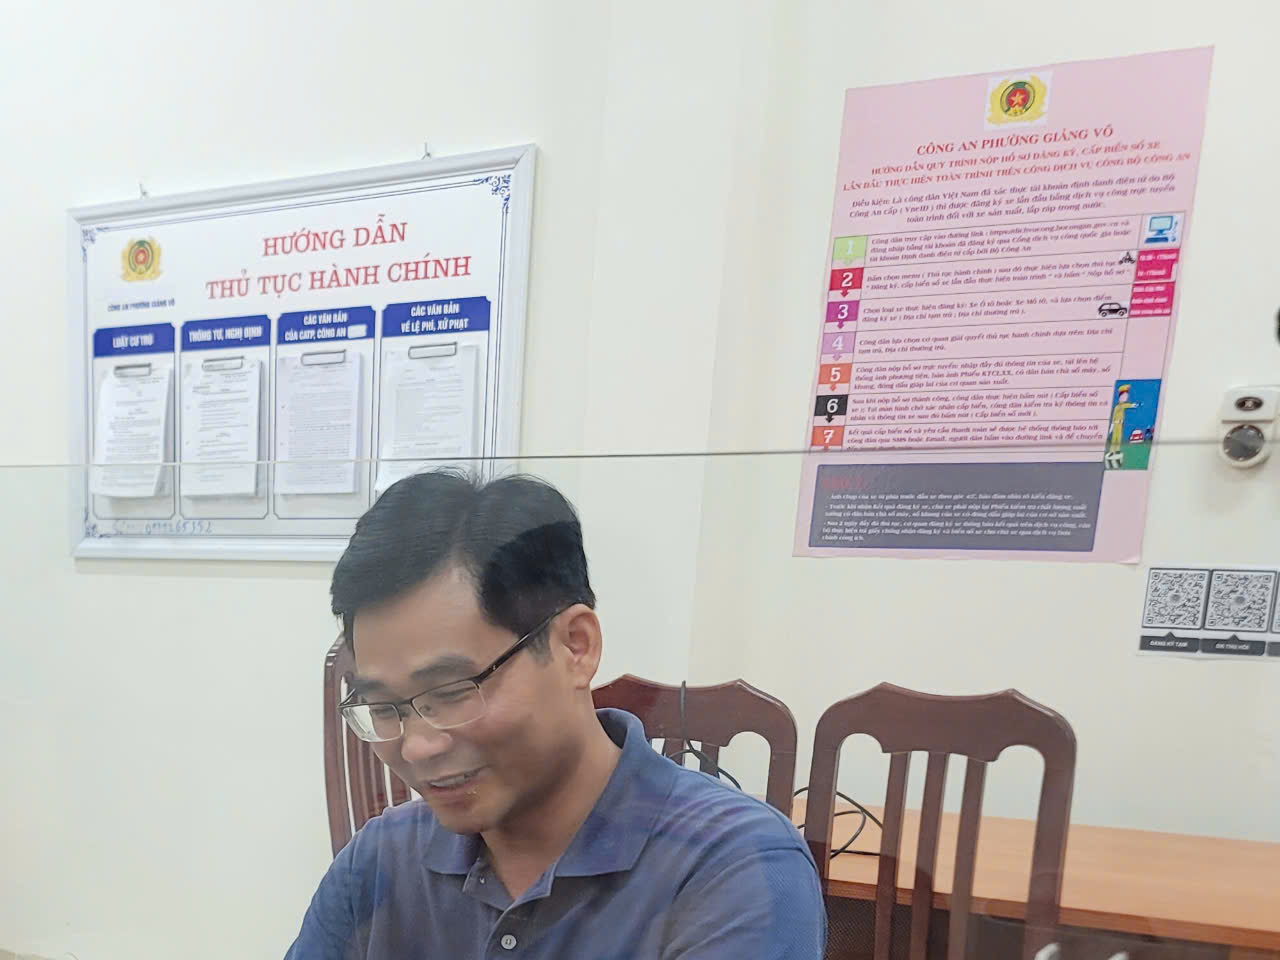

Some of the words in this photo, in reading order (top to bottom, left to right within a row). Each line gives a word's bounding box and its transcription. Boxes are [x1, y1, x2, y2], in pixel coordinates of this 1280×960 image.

[916, 140, 954, 155] CÔNG
[958, 140, 978, 151] AN
[980, 131, 1039, 149] PHƯỜNG
[1042, 126, 1089, 143] GIẢNG
[1092, 124, 1113, 138] VÕ
[904, 160, 924, 172] DẪN
[926, 161, 945, 171] QUY
[942, 192, 958, 200] Việt
[262, 223, 346, 256] HƯỚNG
[352, 210, 408, 246] DẪN
[847, 240, 853, 254] 1
[205, 268, 249, 299] THỦ
[257, 272, 302, 300] TỤC
[308, 259, 380, 290] HÀNH
[387, 248, 472, 282] CHÍNH
[842, 272, 852, 286] 2
[410, 303, 425, 316] CÁC
[426, 302, 442, 315] VĂN
[442, 300, 459, 314] BẢN
[838, 304, 848, 318] 3
[303, 313, 317, 325] CÁC
[400, 320, 410, 332] VỀ
[411, 320, 420, 332] LỆ
[421, 318, 435, 332] PHÍ,
[436, 316, 448, 330] XỬ
[448, 316, 468, 330] PHẠT
[188, 328, 211, 342] THÔNG
[224, 326, 243, 341] NGHỊ
[244, 325, 262, 340] ĐỊNH
[316, 325, 335, 338] CÔNG
[335, 326, 346, 336] AN
[832, 336, 843, 350] 4
[830, 367, 840, 381] 5
[826, 398, 838, 413] 6
[823, 429, 833, 443] 7
